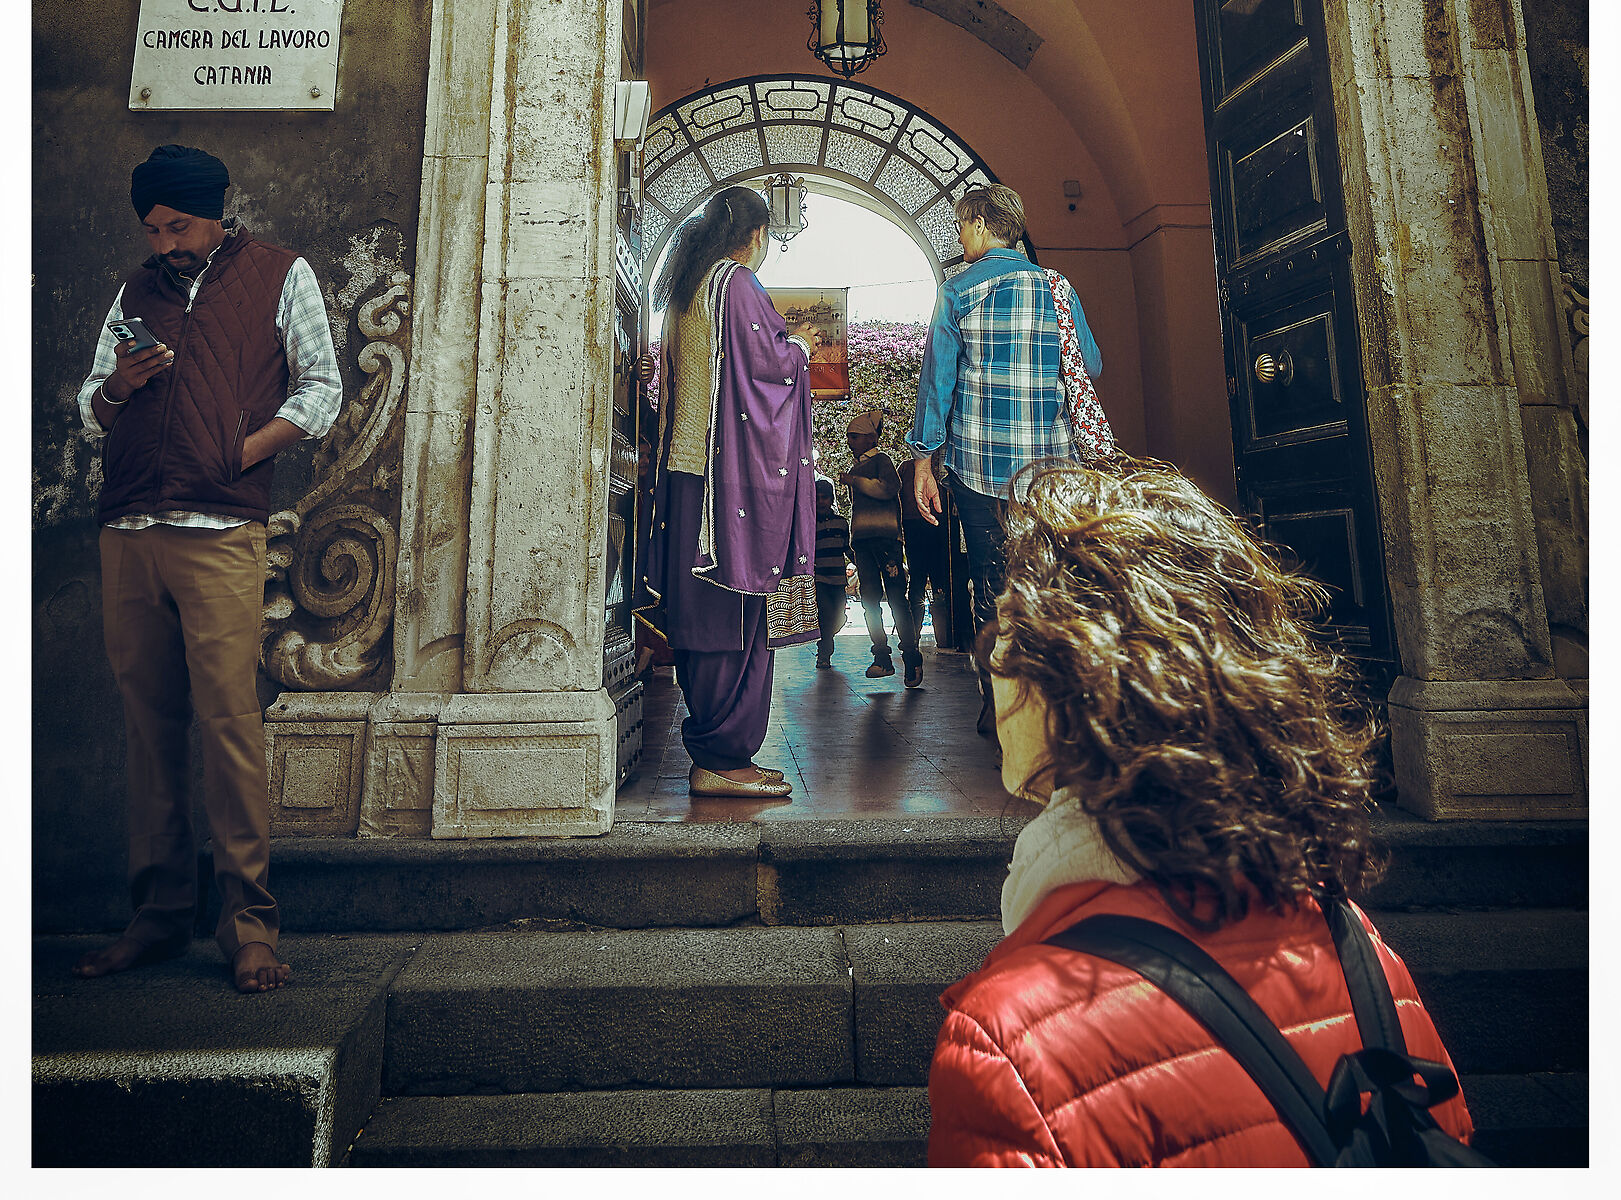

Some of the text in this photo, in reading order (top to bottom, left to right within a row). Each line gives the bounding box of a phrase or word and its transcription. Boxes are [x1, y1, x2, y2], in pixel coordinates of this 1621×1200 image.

[143, 29, 330, 49] CAMERA DEL LAVORO
[193, 65, 272, 85] CATANIA
